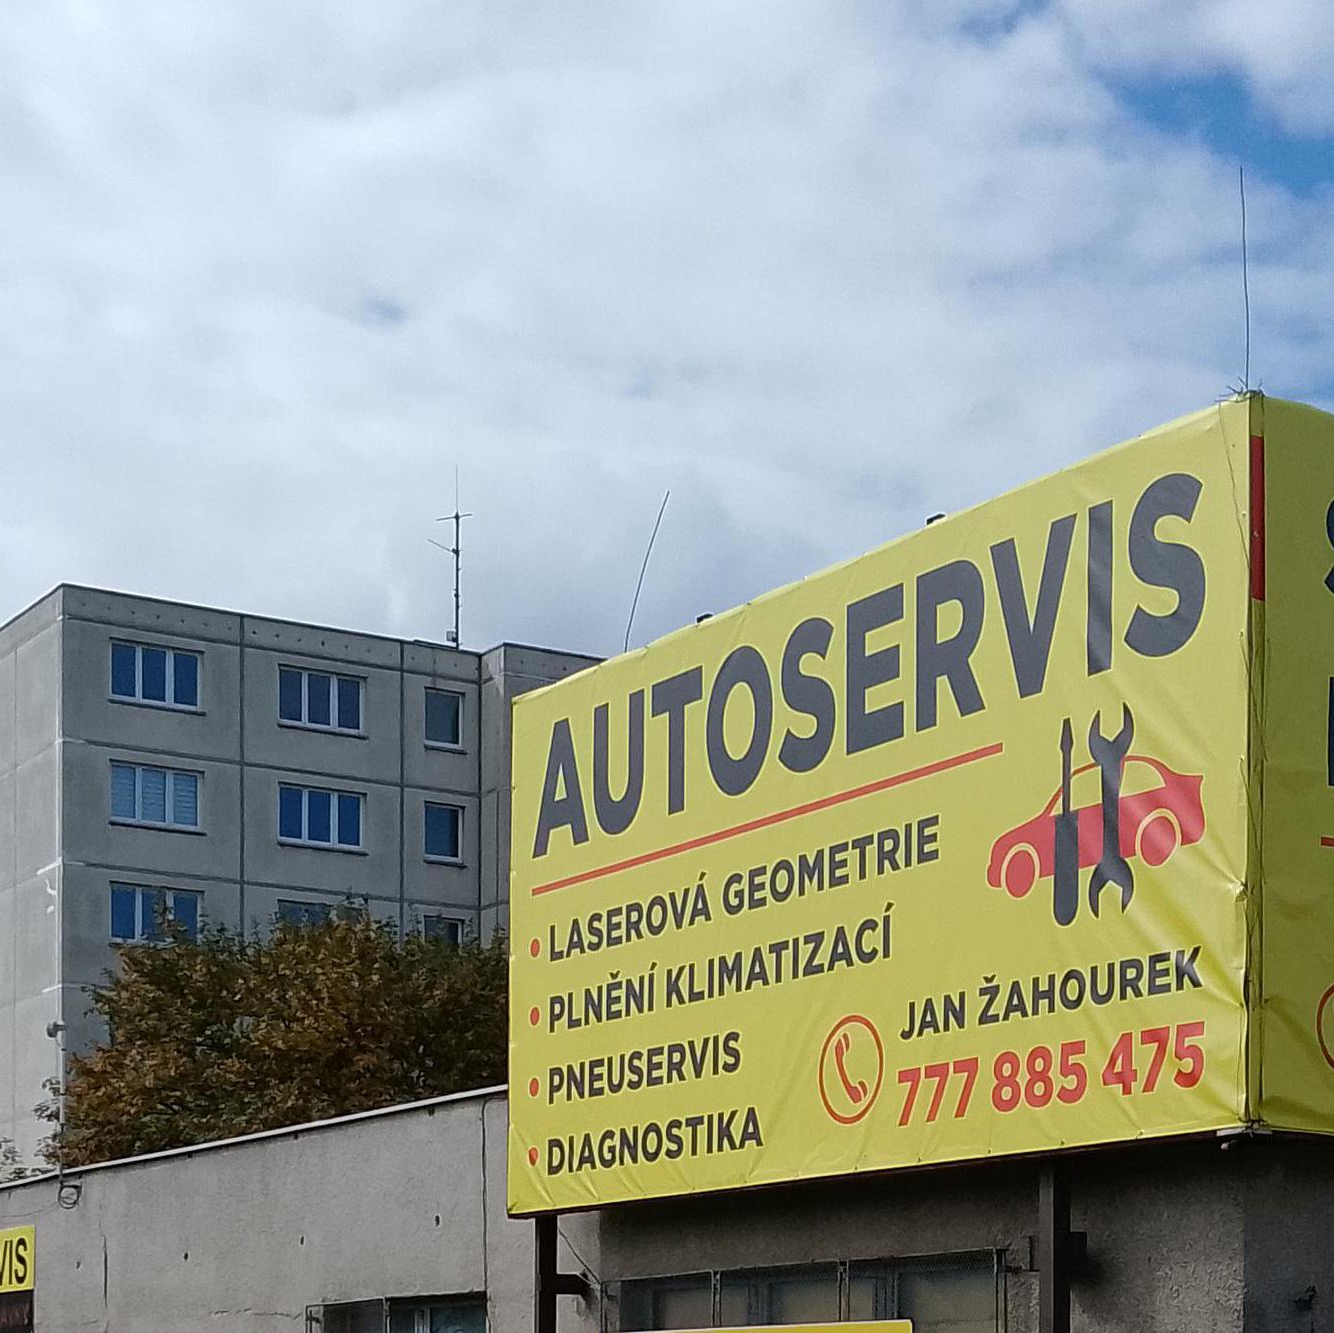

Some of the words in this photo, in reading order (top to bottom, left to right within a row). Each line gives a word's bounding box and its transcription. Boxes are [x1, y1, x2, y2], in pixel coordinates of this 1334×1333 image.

[531, 473, 1207, 858] AUTOSERVIS
[548, 871, 713, 963] LASEROVÁ
[723, 814, 942, 917] GEOMETRIE
[548, 963, 657, 1034] PLNĚNÍ
[666, 902, 894, 1009] KLIMATIZACÍ
[899, 994, 966, 1041] JAN
[977, 946, 1205, 1026] ŽAHOUREK
[547, 1031, 742, 1105] PNEUSERVIS
[897, 1057, 980, 1127] 777
[991, 1039, 1088, 1113] 885
[1101, 1021, 1207, 1097] 475
[547, 1106, 764, 1177] DIAGNOSTIKA
